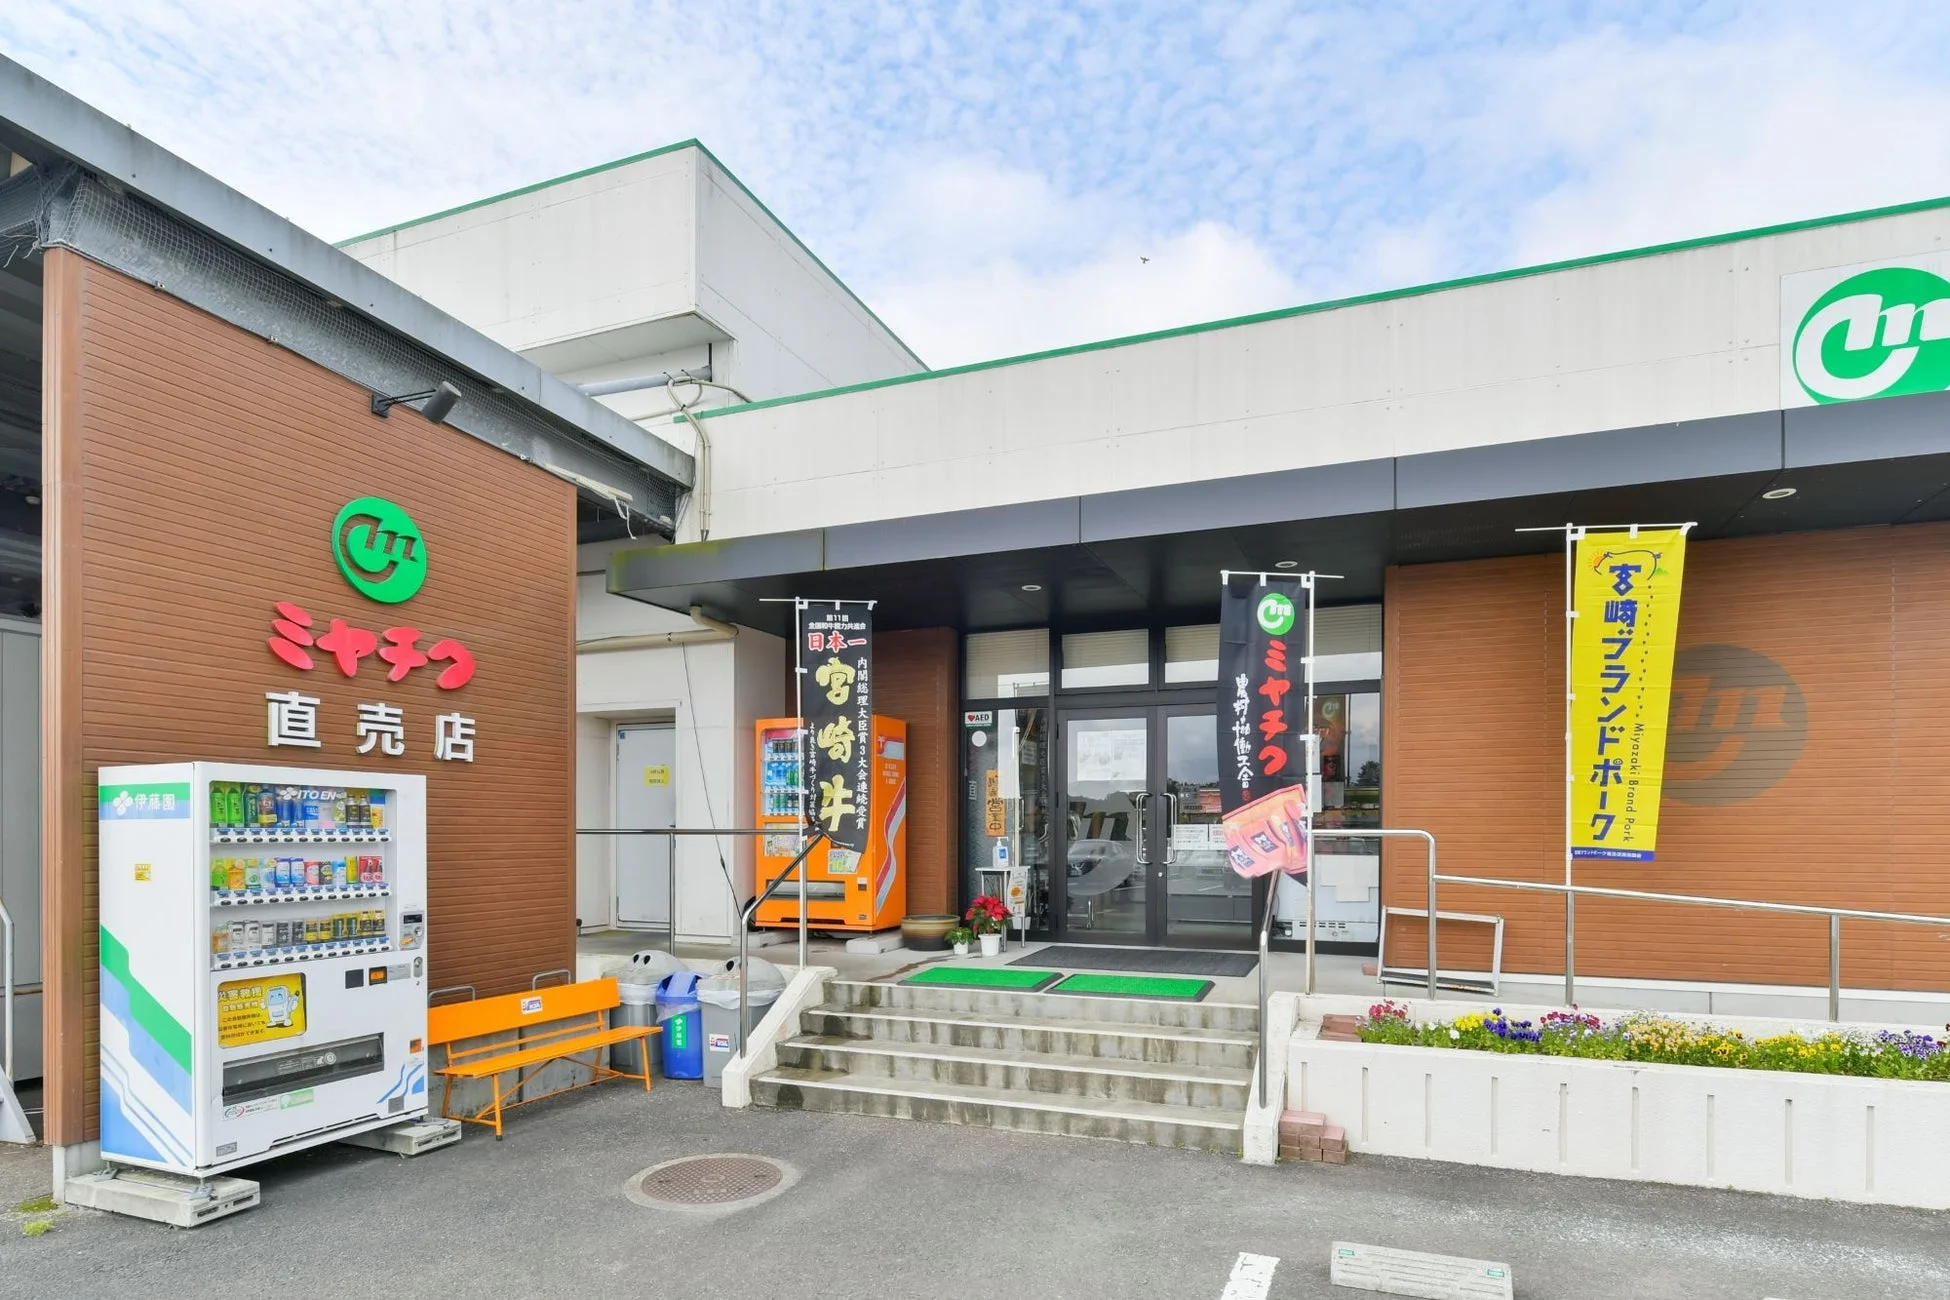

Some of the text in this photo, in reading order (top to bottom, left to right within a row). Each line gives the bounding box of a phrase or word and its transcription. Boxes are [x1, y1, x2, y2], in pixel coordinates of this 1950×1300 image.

[808, 630, 867, 654] 日本一
[975, 713, 990, 722] AED
[1589, 563, 1642, 841] 宮崎ブランドポーク
[265, 691, 476, 763] 直売店
[815, 656, 856, 833] 宮崎牛
[134, 793, 176, 811] 伊藤園
[298, 790, 337, 801] ITO EN
[1623, 723, 1644, 842] Miyazaki Brand Pork
